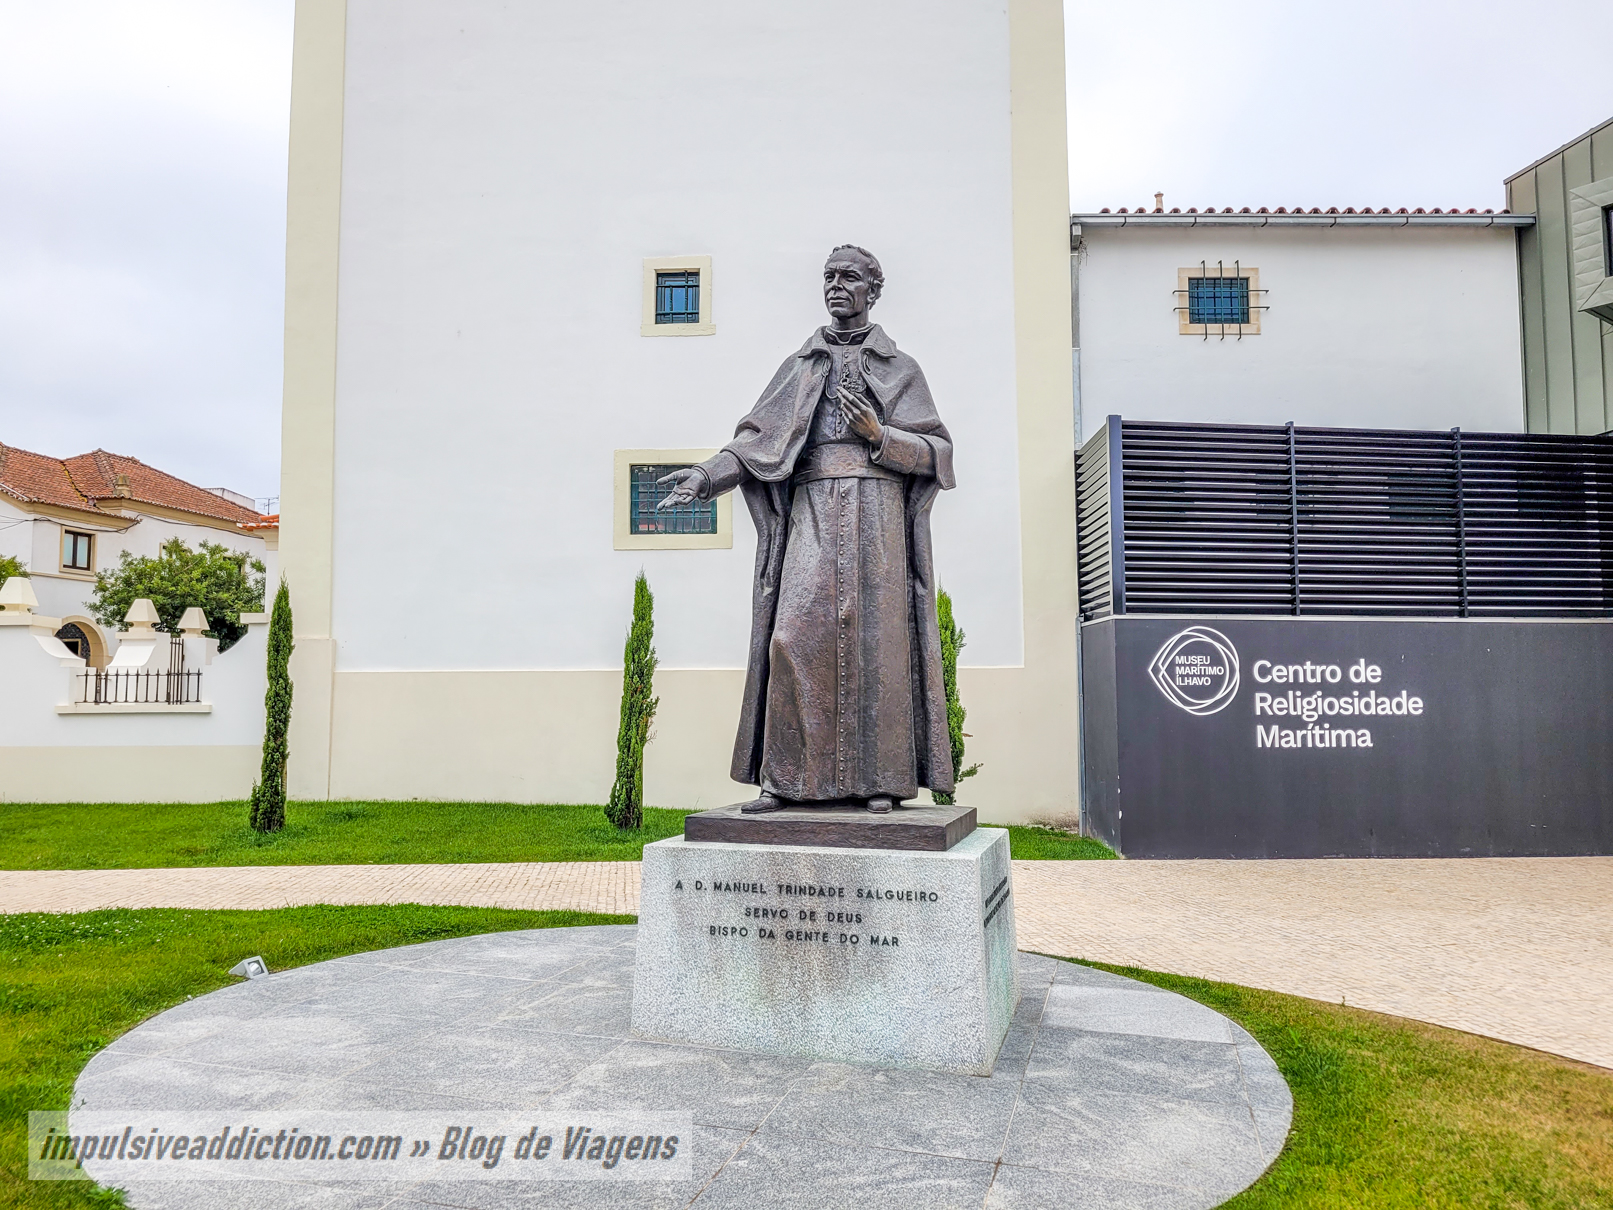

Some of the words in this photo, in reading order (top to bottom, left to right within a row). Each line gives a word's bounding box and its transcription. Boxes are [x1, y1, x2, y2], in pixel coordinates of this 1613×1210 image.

[1175, 655, 1210, 665] MUSEU
[1176, 664, 1224, 675] MARÍTIMO
[1253, 660, 1342, 683] Centro
[1349, 658, 1382, 683] de
[1176, 674, 1211, 686] ÍLHAVO
[1255, 690, 1423, 722] Religiosidade
[1256, 723, 1373, 748] Marítima
[674, 879, 684, 890] A
[695, 880, 707, 891] D.
[713, 881, 767, 895] MANUEL
[777, 884, 845, 898] TRINDADE
[856, 888, 939, 902] SALGUEIRO
[744, 907, 789, 919] SERVO
[799, 910, 816, 921] DE
[827, 911, 863, 924] DEUS
[709, 925, 749, 938] BISPO
[758, 928, 776, 939] DA
[785, 930, 830, 943] GENTE
[839, 933, 860, 945] DO
[870, 935, 899, 947] MAR
